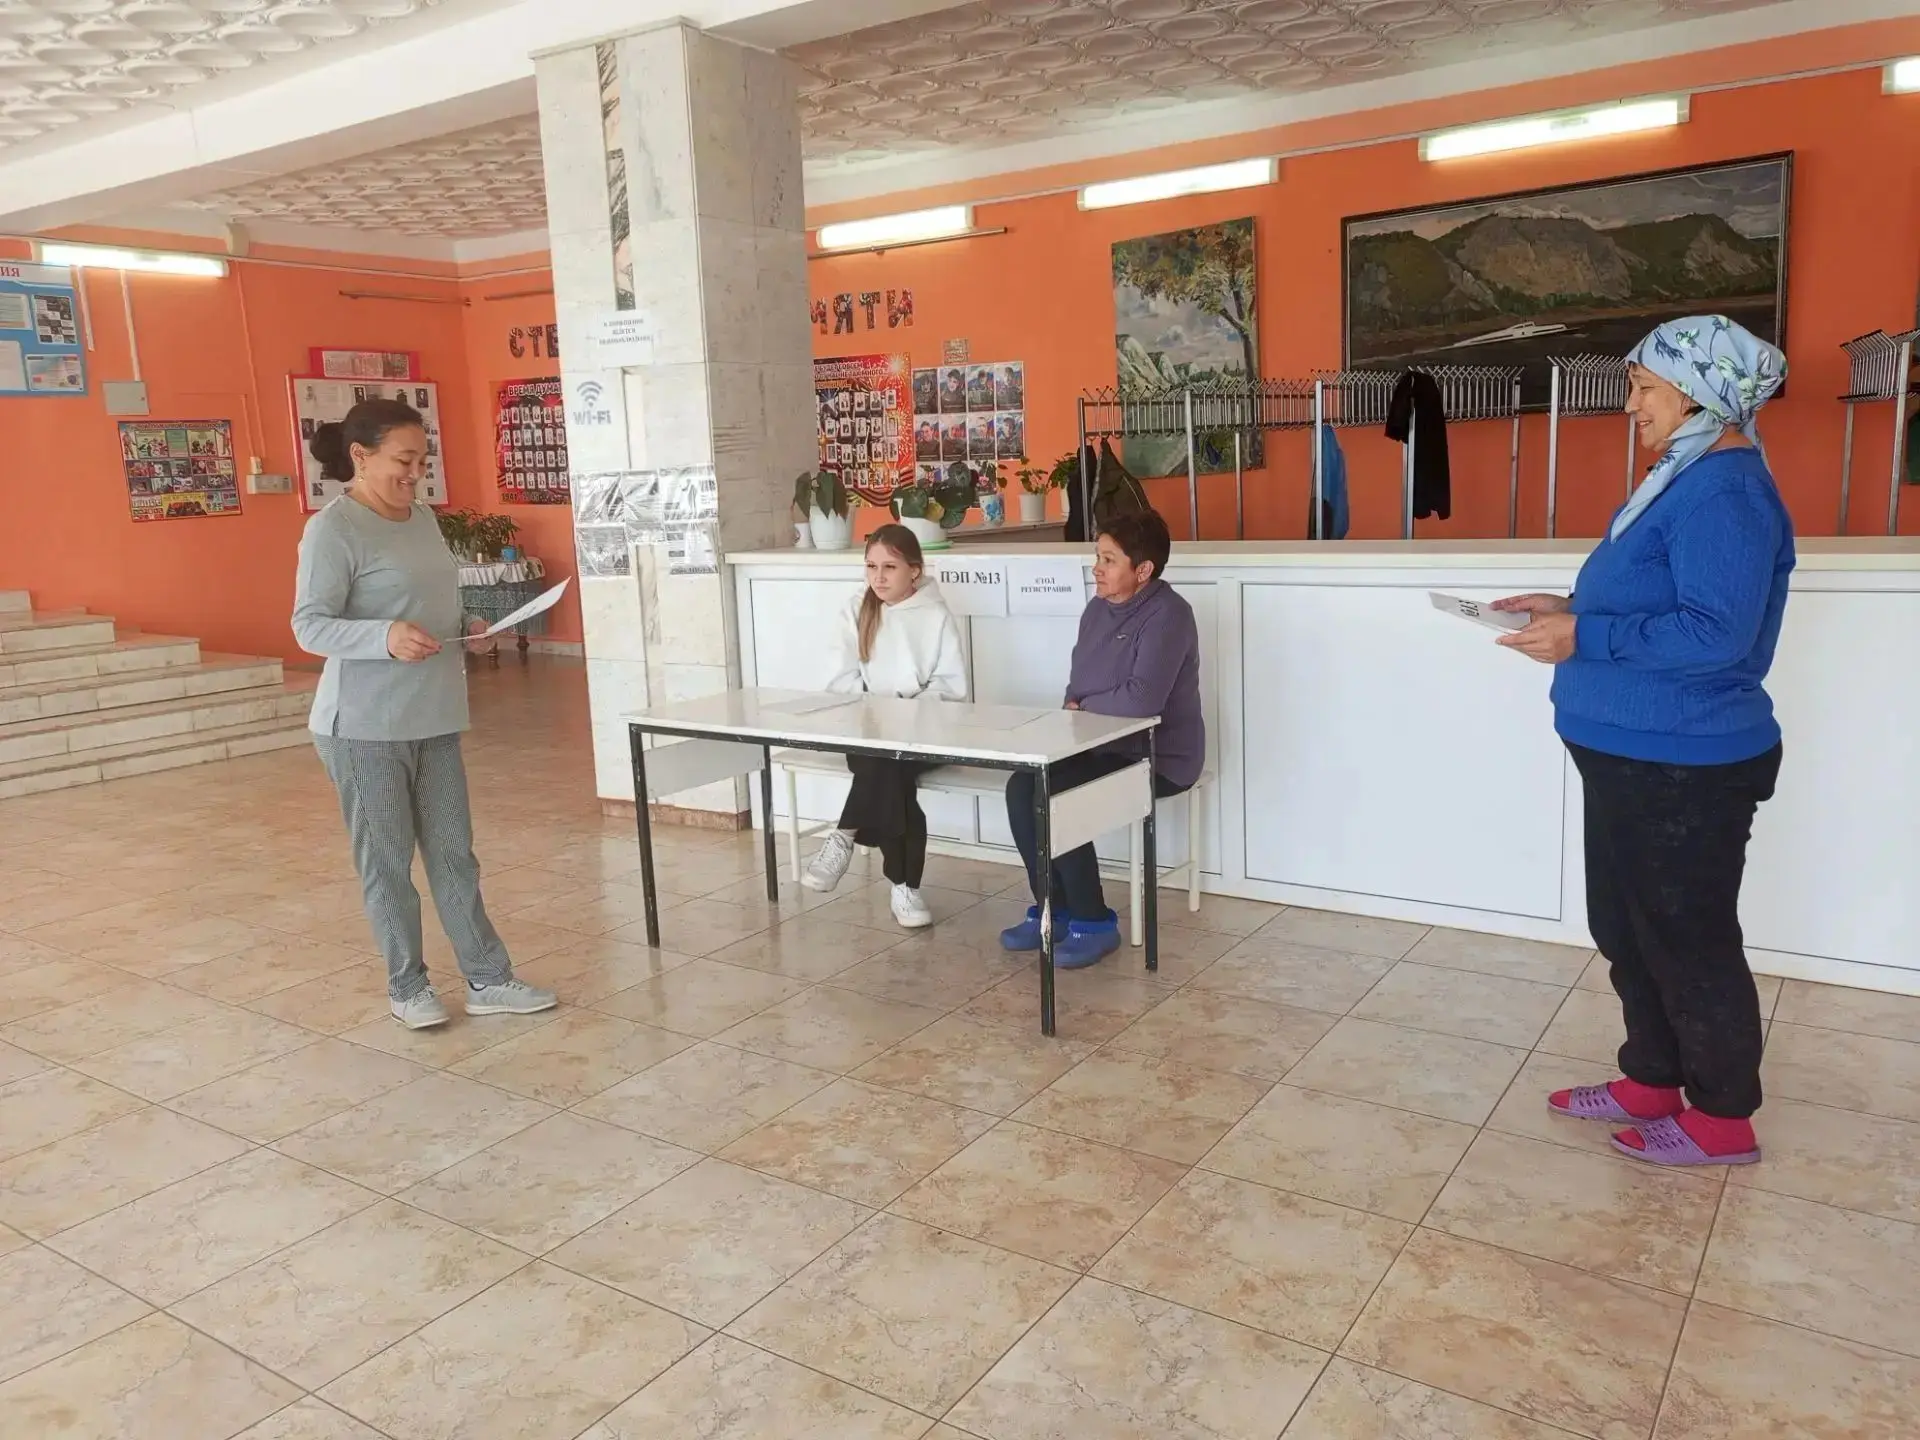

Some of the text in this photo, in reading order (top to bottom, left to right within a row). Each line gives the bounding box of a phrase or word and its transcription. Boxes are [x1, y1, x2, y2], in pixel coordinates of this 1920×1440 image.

[508, 384, 535, 397] ВРЕМЯ
[940, 571, 1001, 585] ПЭП №13
